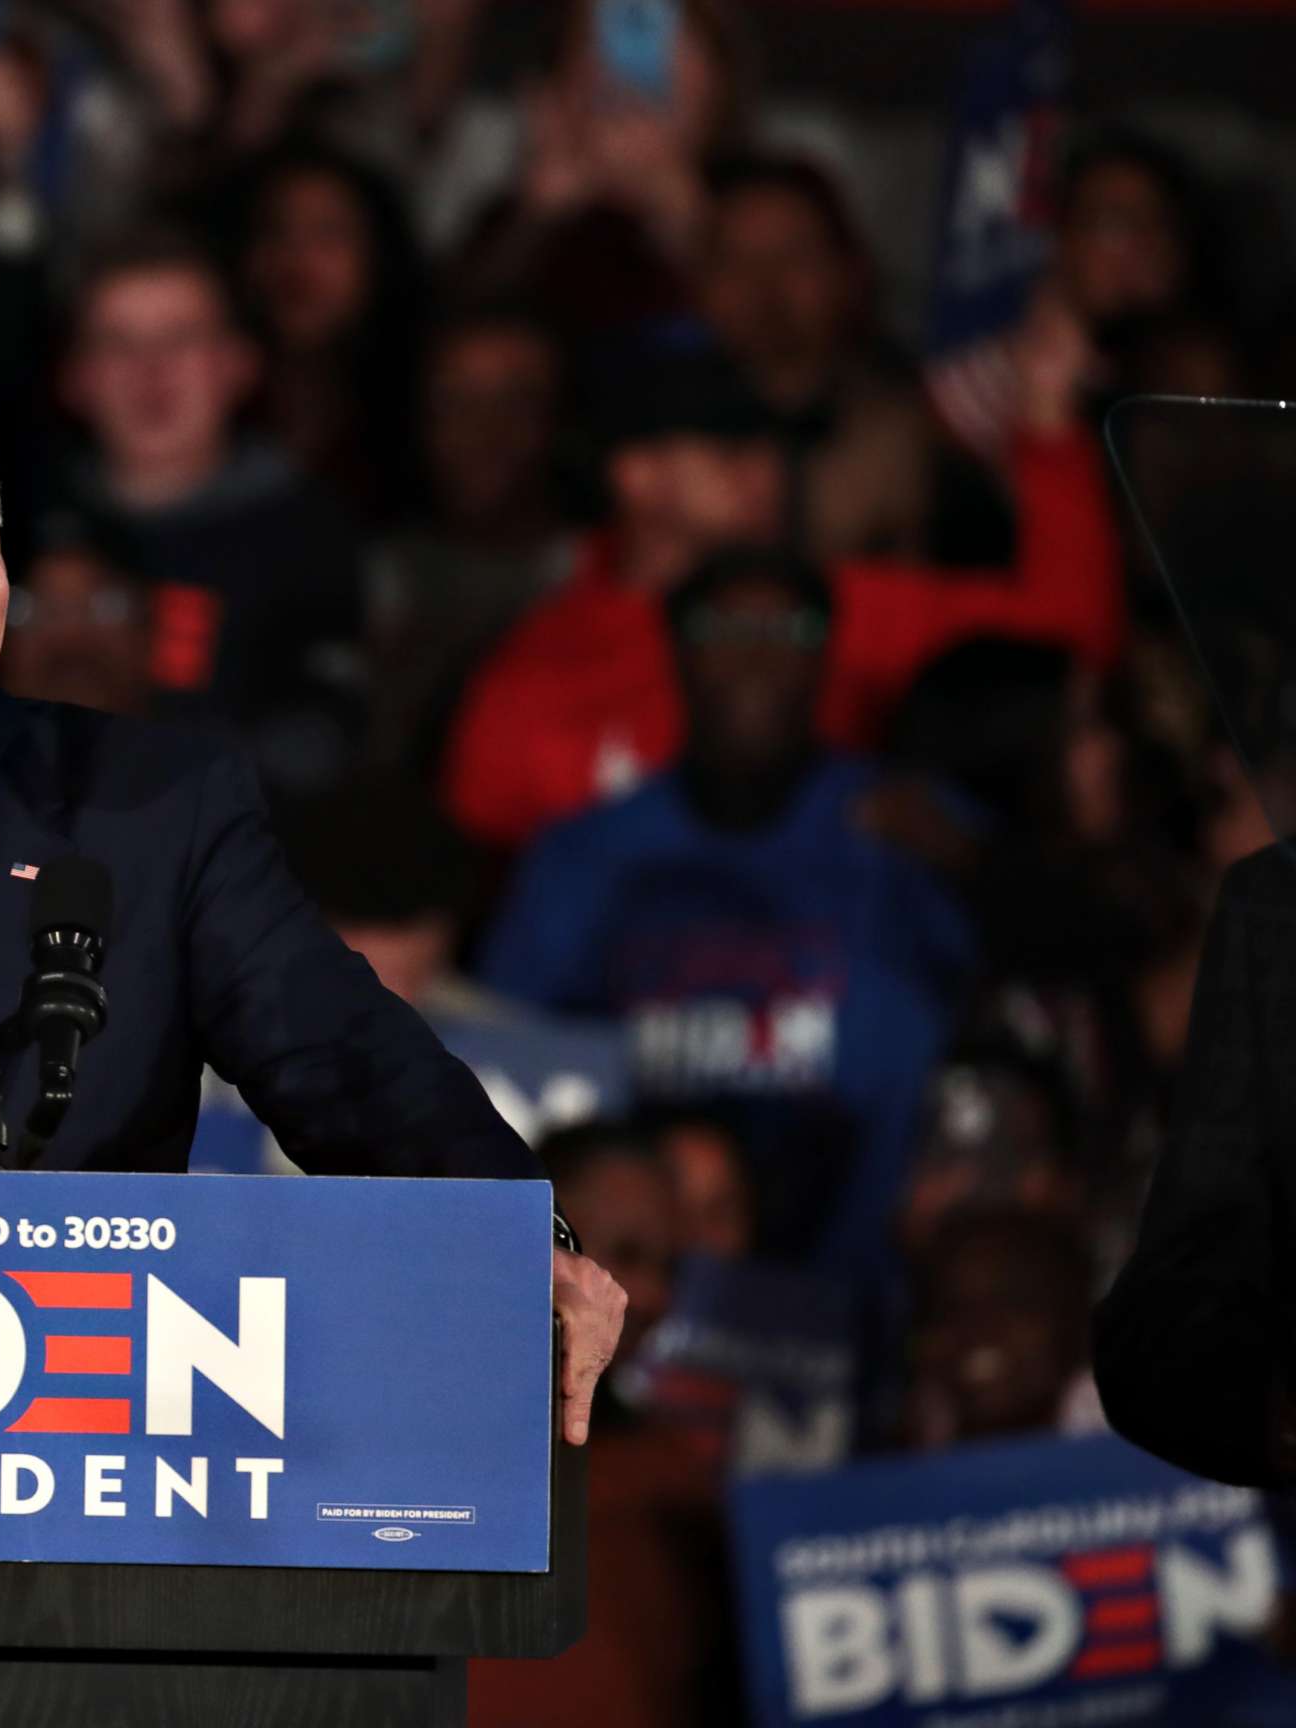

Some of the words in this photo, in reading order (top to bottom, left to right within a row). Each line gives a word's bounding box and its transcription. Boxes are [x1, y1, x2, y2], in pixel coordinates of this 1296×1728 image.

[17, 1218, 56, 1248] to
[64, 1216, 176, 1250] 30330
[321, 1508, 343, 1517] PAID
[344, 1508, 362, 1518] FOR
[363, 1508, 375, 1518] BY
[376, 1509, 403, 1518] BIDEN
[404, 1509, 422, 1519] FOR
[423, 1510, 471, 1520] PRESIDENT
[784, 1525, 1278, 1716] BIDEN
